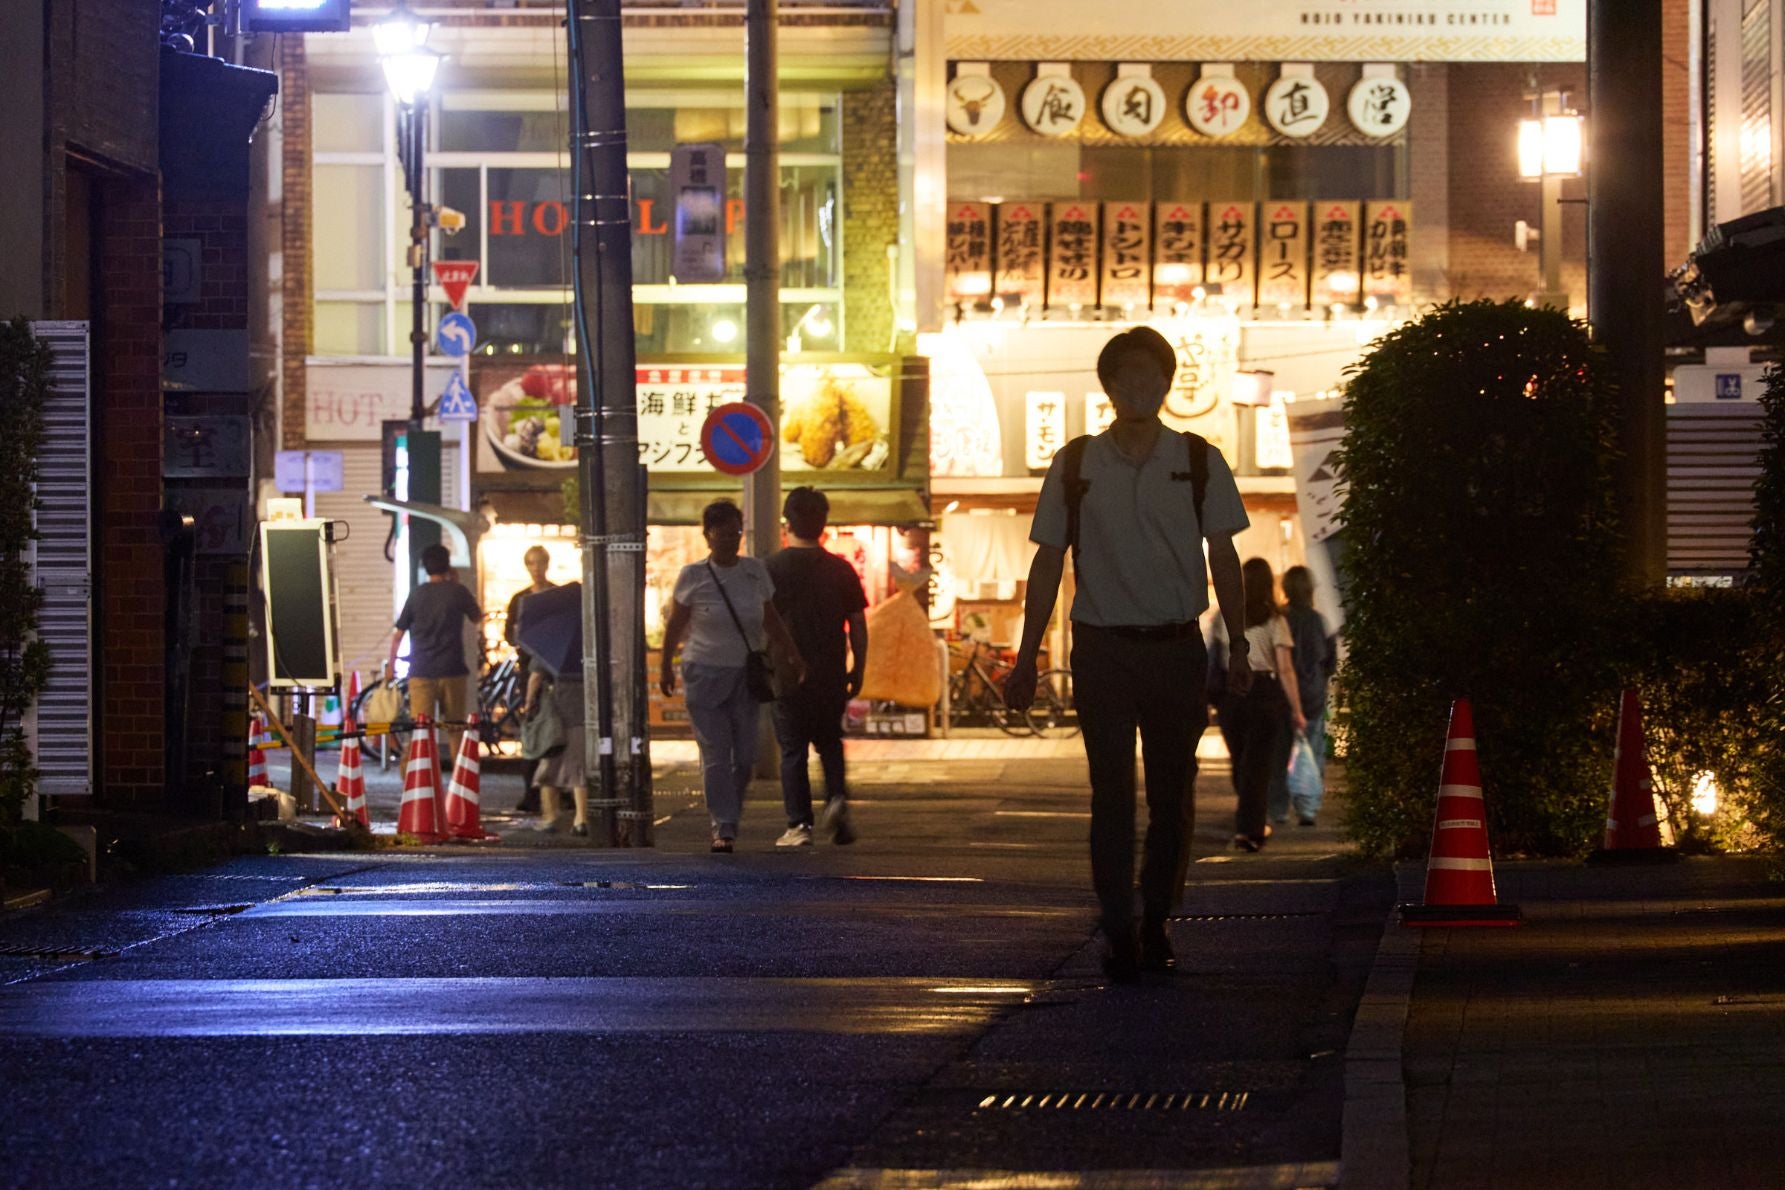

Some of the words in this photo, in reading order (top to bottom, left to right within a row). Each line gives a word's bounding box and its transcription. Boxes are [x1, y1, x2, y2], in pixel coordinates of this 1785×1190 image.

[1446, 13, 1510, 25] CENTER
[1110, 220, 1143, 280] トントロ
[1269, 221, 1300, 280] ロース
[678, 421, 690, 435] と
